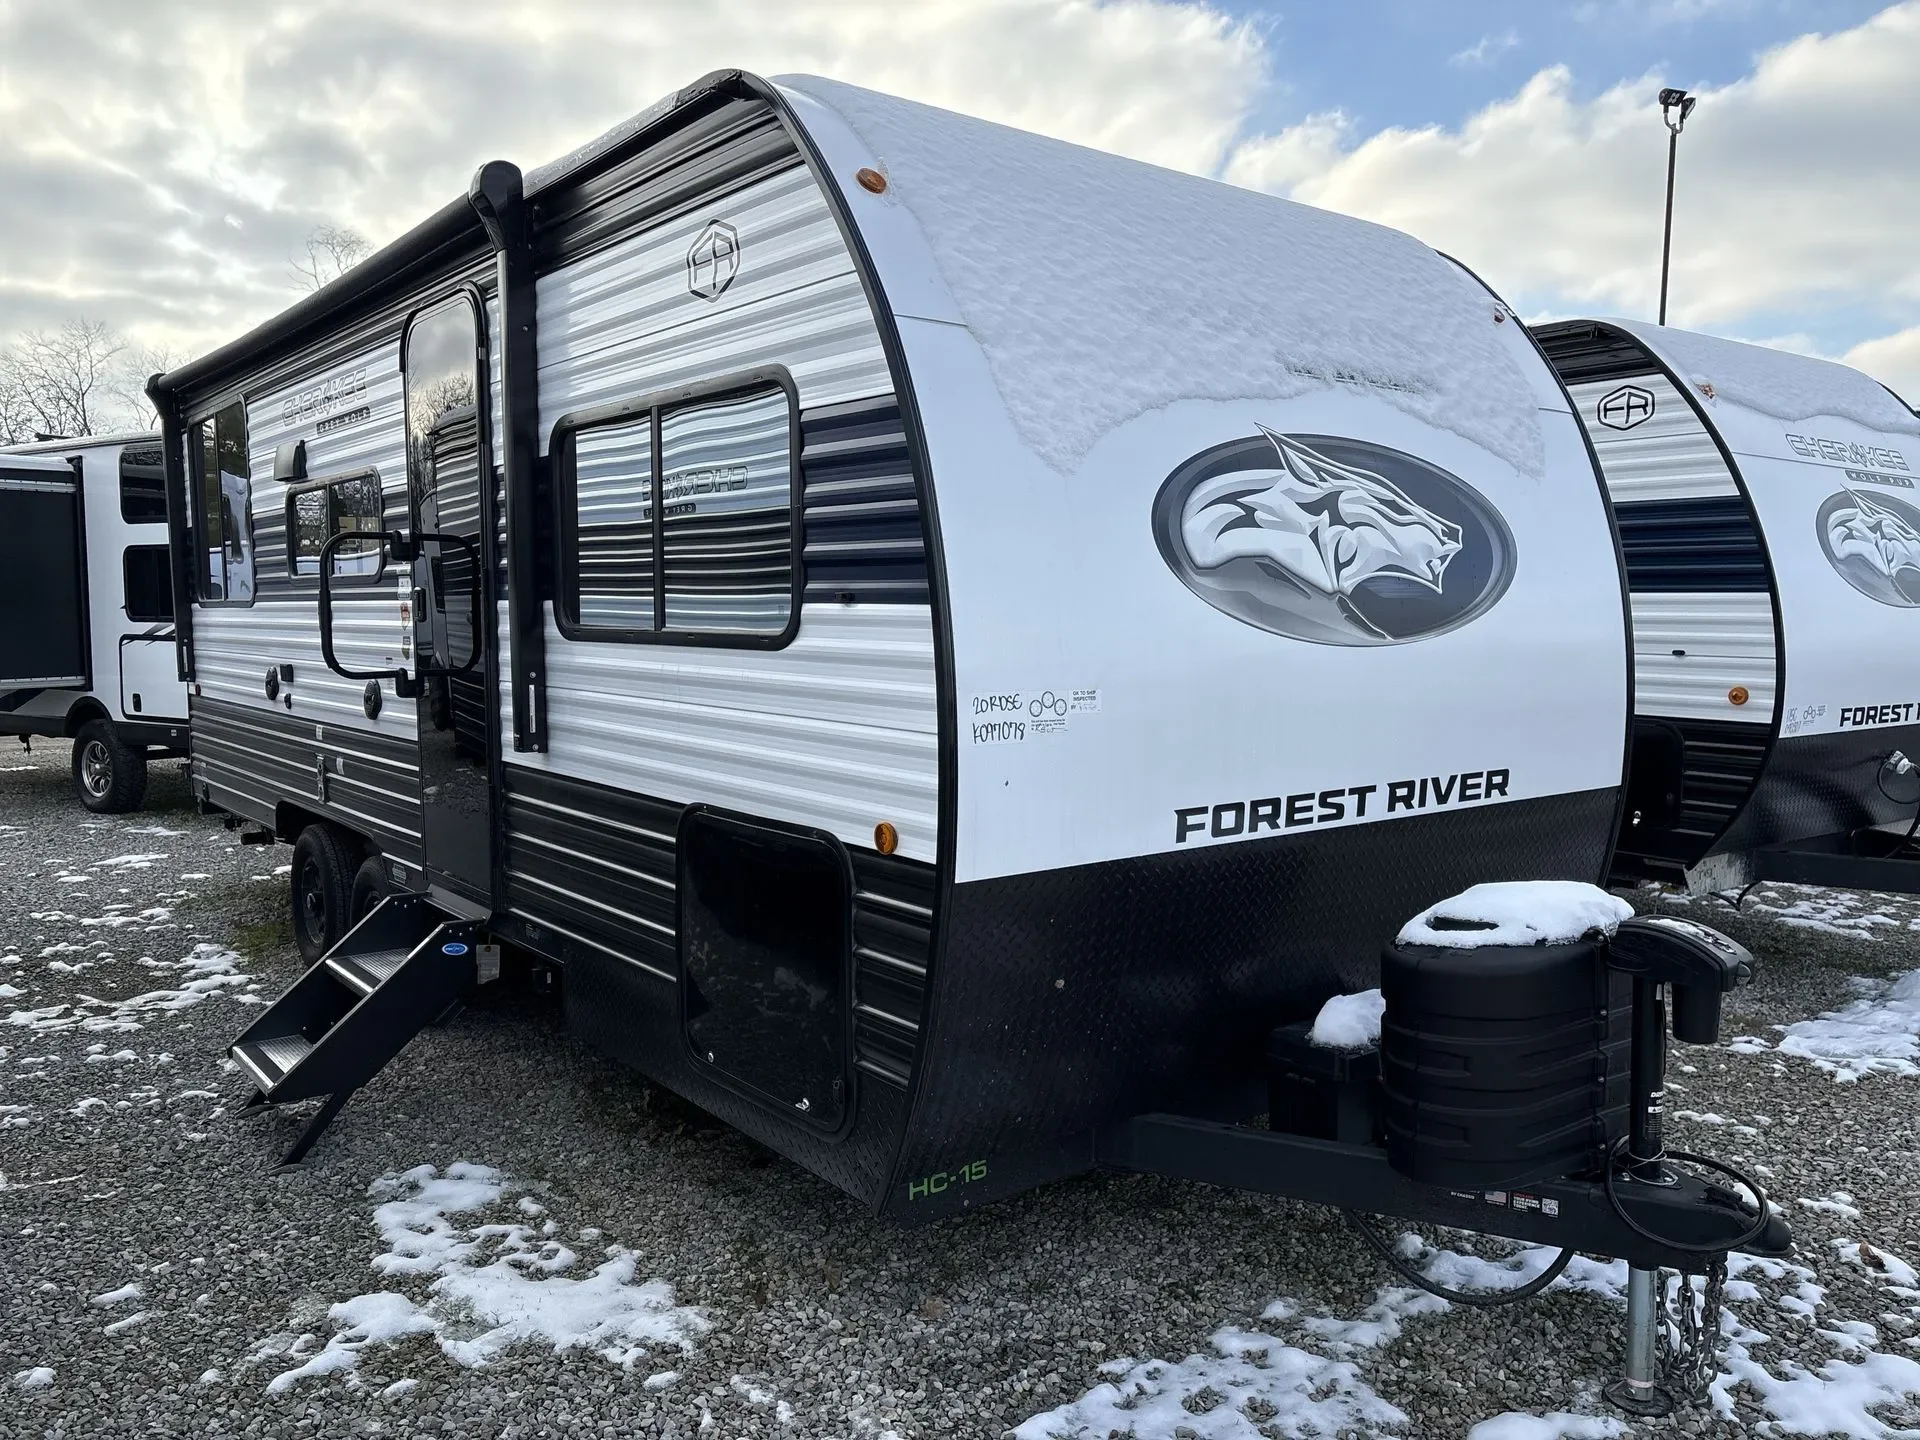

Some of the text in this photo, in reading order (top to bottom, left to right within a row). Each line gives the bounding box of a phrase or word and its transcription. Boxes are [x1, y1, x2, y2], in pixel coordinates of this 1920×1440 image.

[282, 367, 368, 427] CHEROKEE
[1785, 433, 1911, 472] CHEROKEE
[1840, 703, 1914, 728] FOREST
[1174, 768, 1510, 844] FOREST RIVER
[909, 1160, 987, 1201] HC-15
